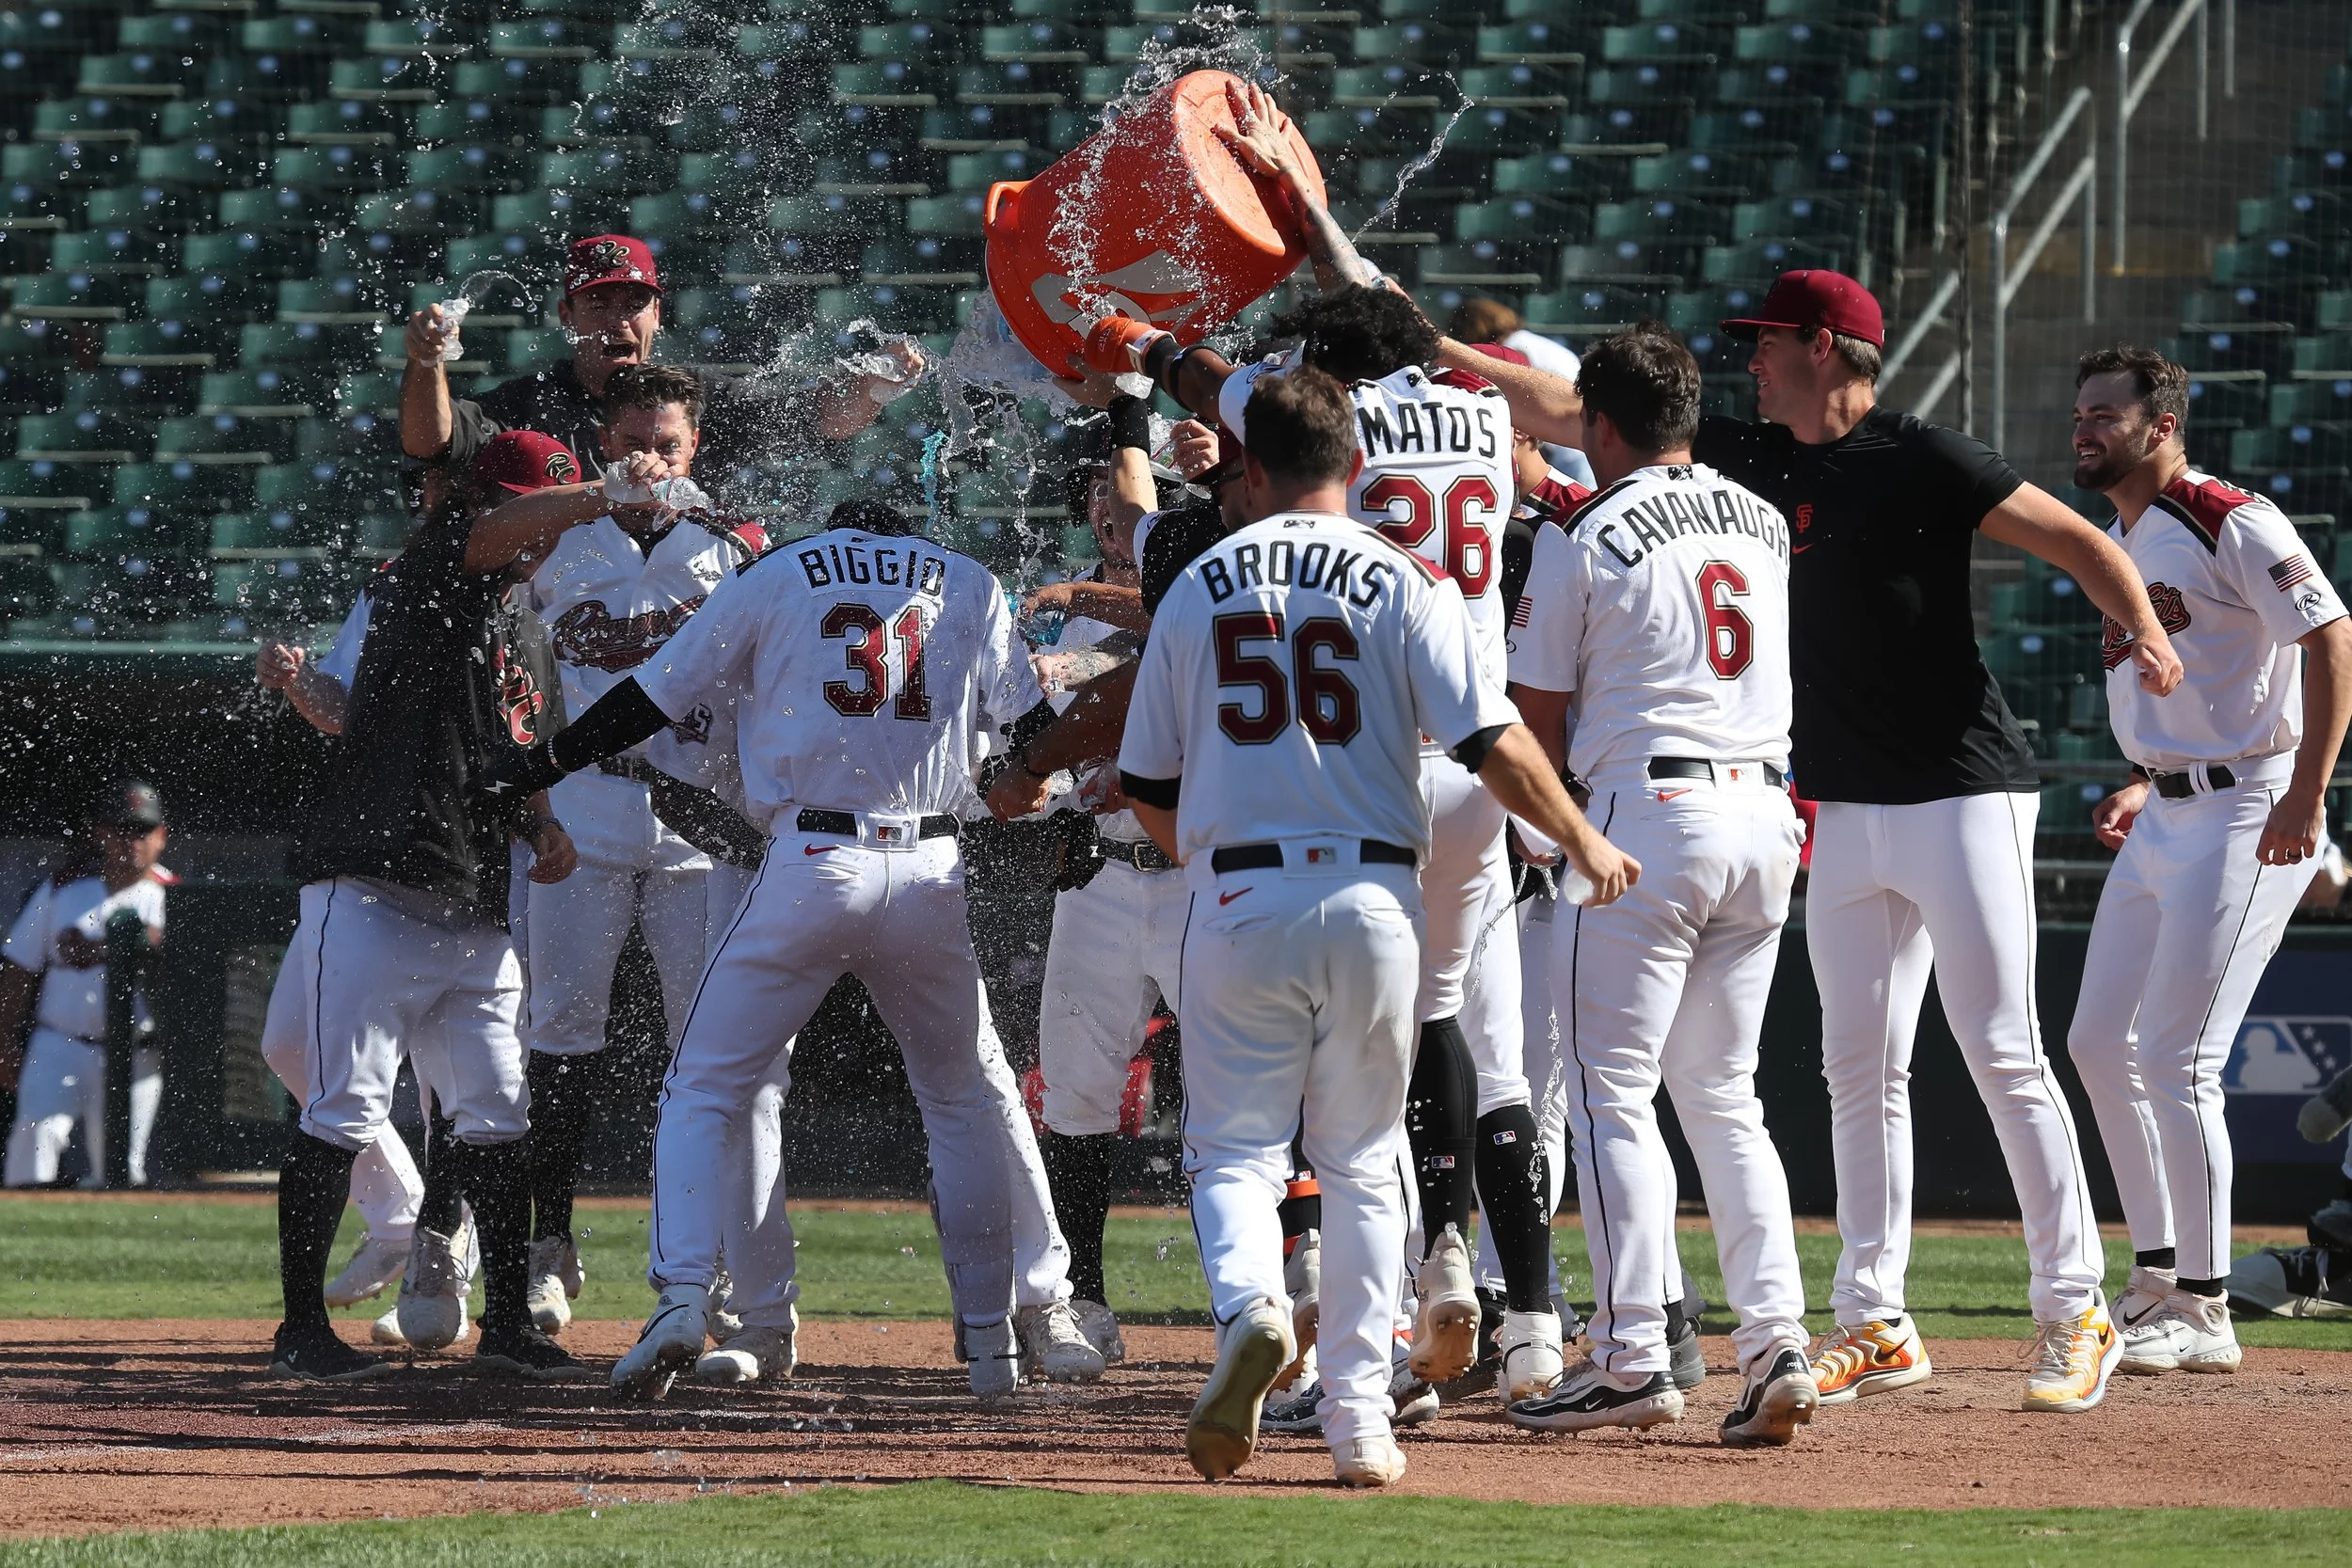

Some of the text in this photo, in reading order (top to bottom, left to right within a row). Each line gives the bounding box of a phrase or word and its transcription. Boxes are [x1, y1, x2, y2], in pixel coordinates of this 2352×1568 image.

[1358, 402, 1496, 458] MATOS
[798, 543, 946, 596] BIGGIO
[1200, 541, 1391, 608] BROOKS
[1361, 473, 1499, 599] 26
[1597, 490, 1788, 568] CAVANAUGH
[820, 602, 931, 722] 31
[1695, 560, 1754, 680] 6
[1213, 610, 1361, 747] 56
